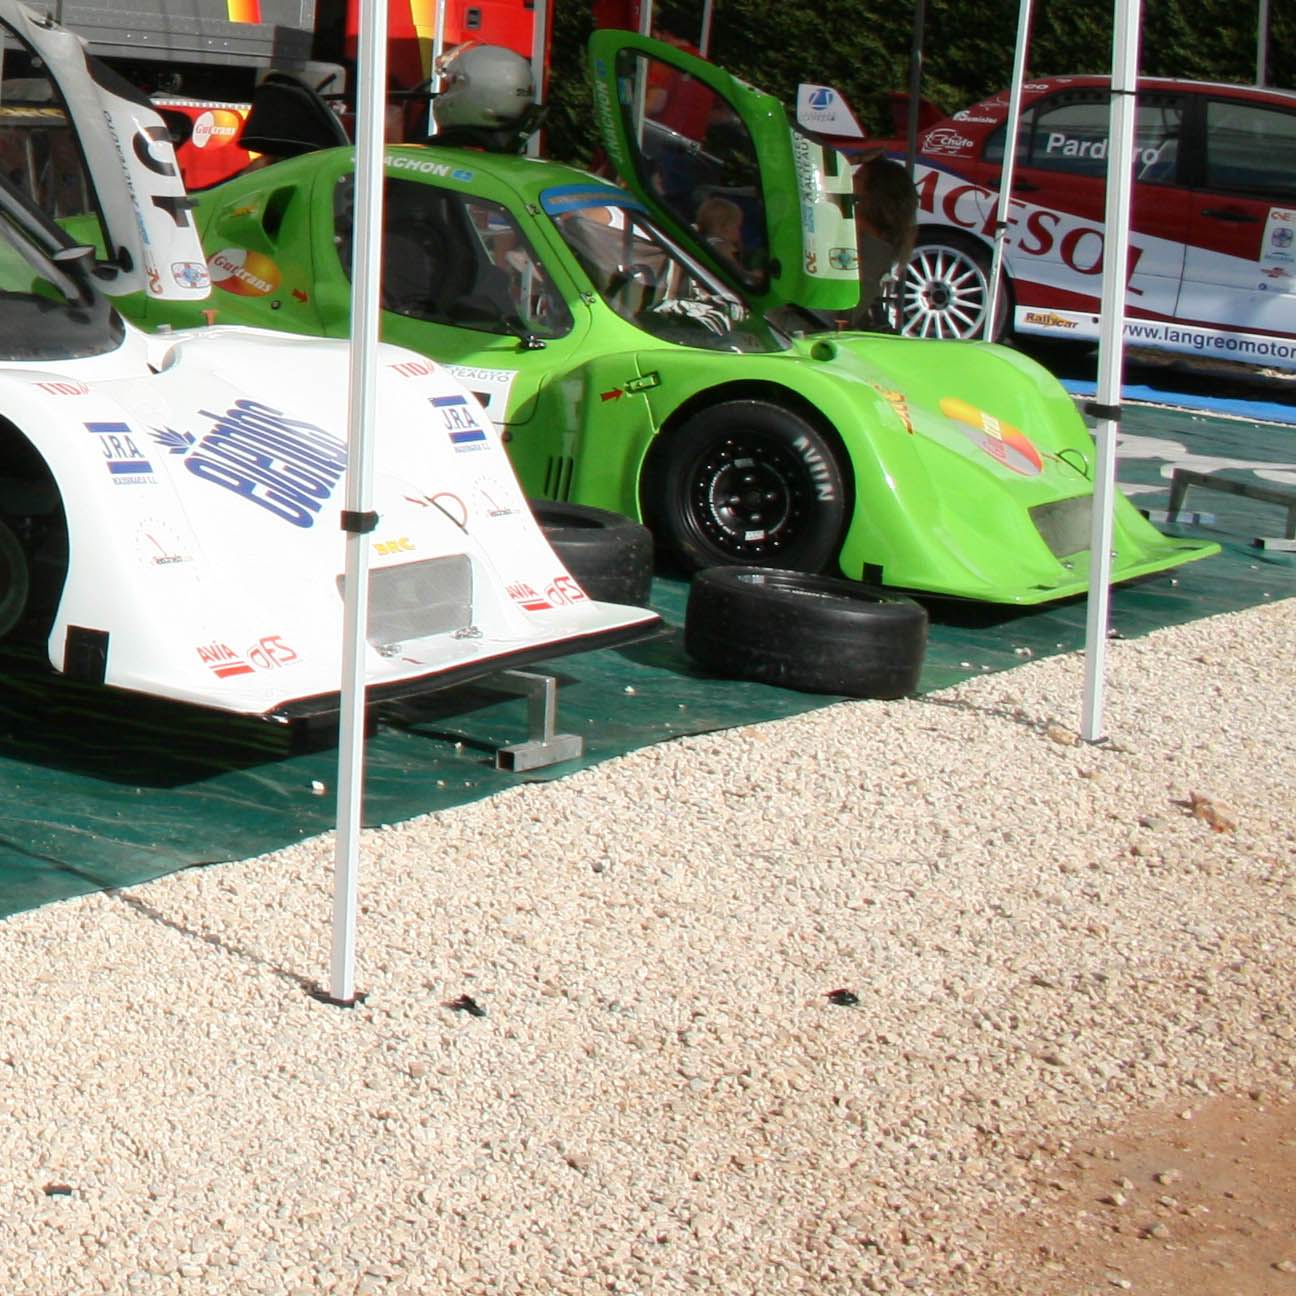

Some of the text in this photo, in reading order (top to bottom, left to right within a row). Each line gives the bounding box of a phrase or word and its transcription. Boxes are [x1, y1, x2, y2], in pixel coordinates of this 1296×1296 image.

[1045, 132, 1160, 166] Pardro
[213, 255, 273, 294] Guttrans
[1122, 323, 1296, 359] ww.langreomotor
